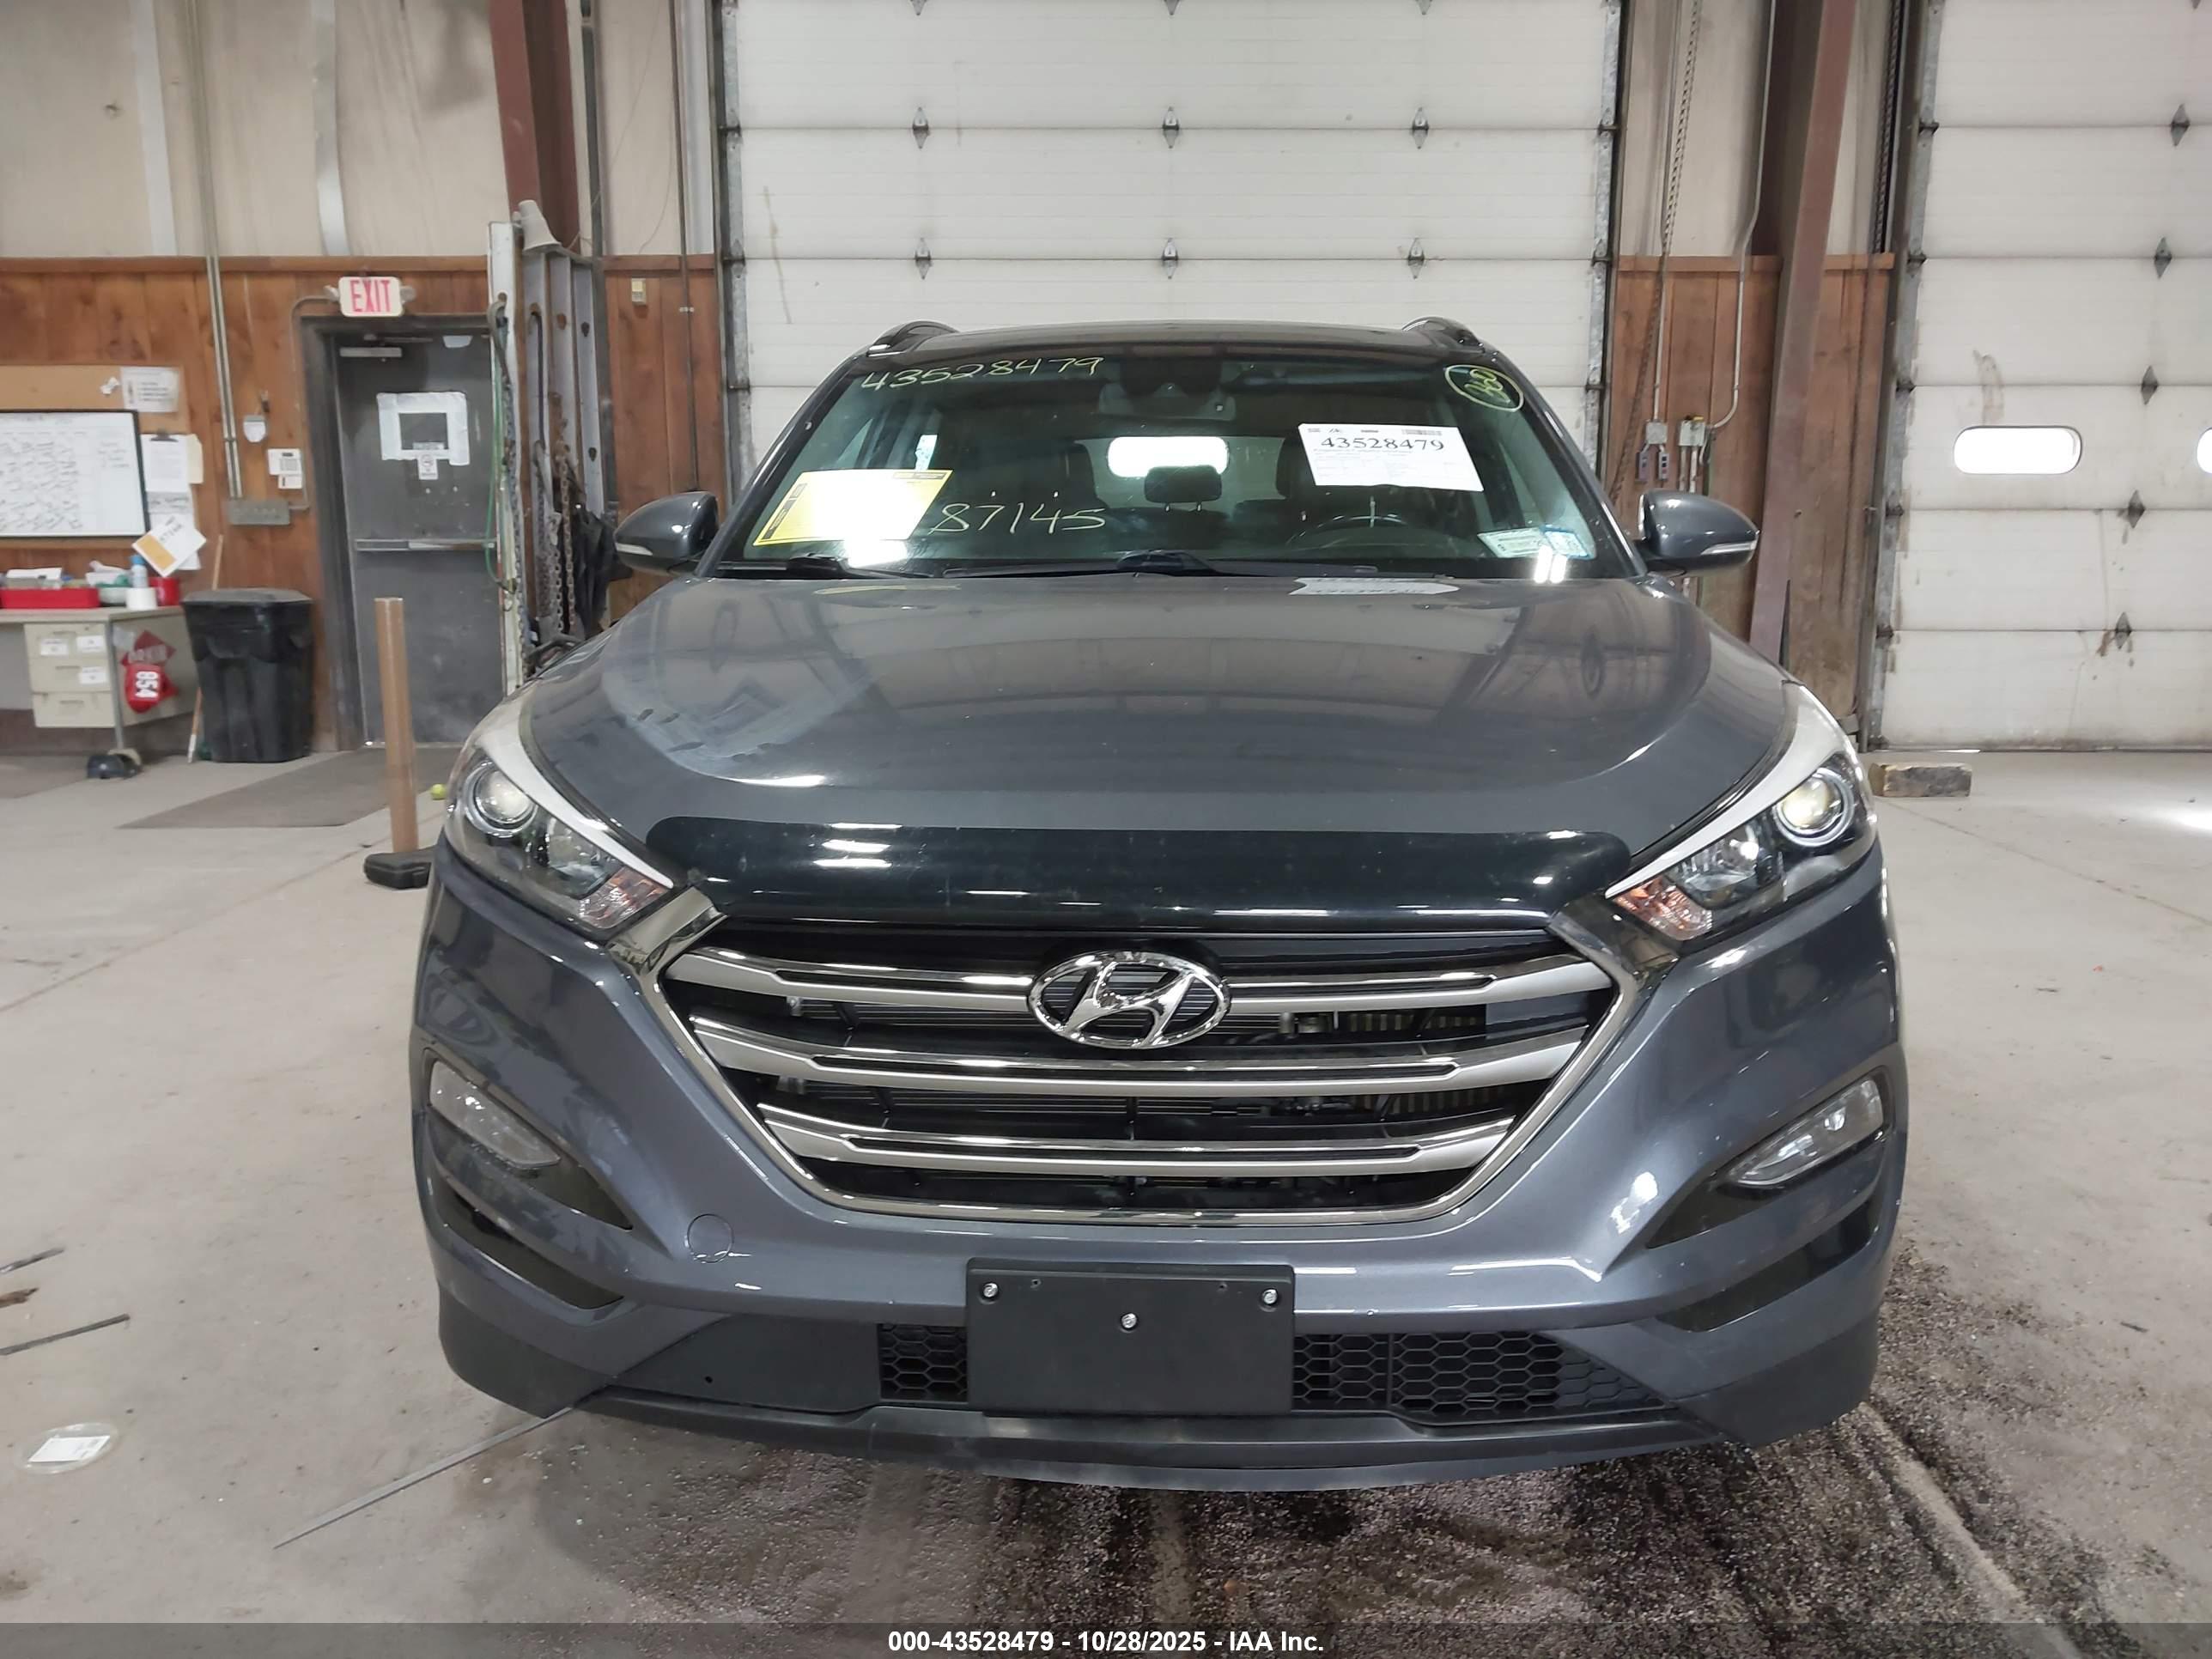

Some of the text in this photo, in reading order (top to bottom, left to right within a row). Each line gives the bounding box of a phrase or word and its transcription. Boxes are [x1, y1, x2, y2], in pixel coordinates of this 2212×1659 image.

[349, 280, 392, 313] EXIT
[860, 356, 1105, 391] 43528479
[1320, 436, 1445, 451] 43528479
[927, 502, 1106, 535] 87145
